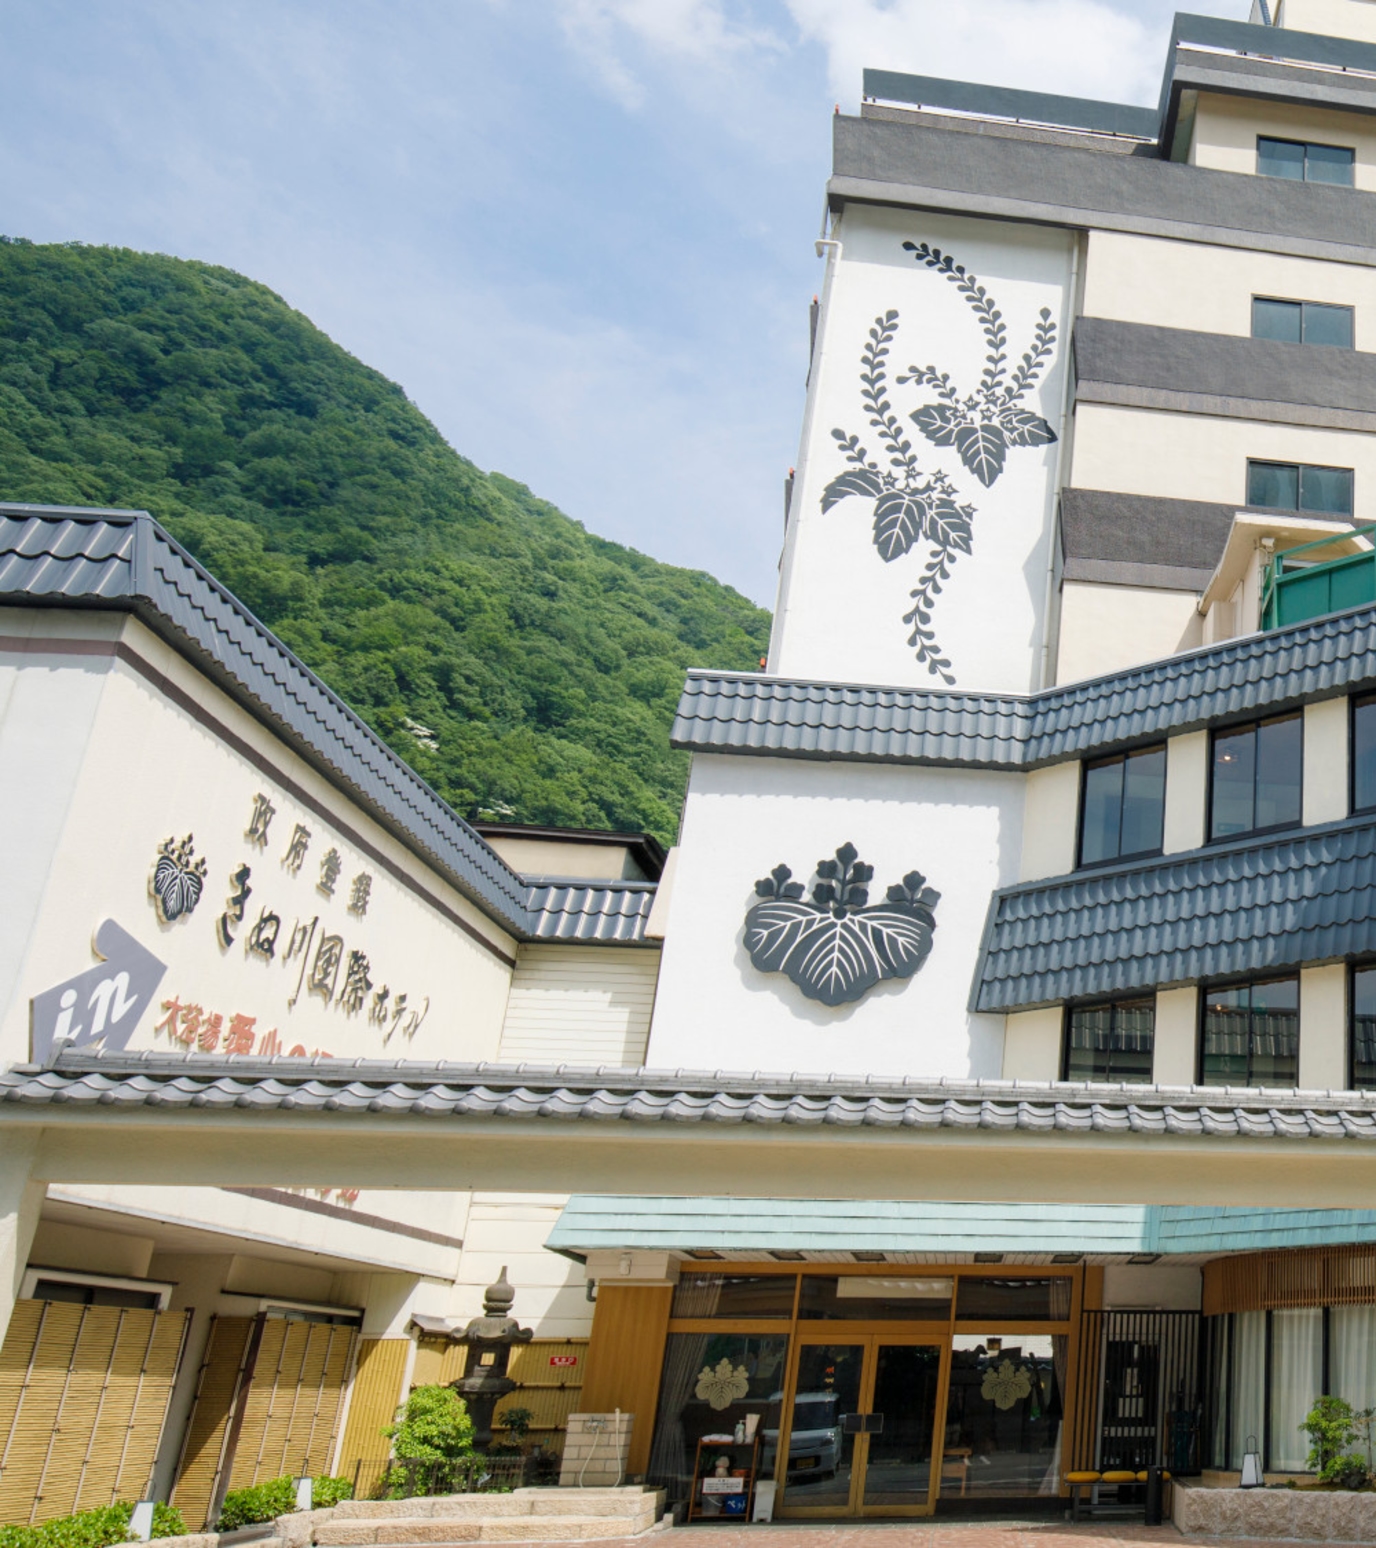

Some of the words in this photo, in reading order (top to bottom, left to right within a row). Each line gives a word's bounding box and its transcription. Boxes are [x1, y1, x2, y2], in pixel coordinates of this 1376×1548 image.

[53, 971, 138, 1040] in
[217, 862, 430, 1042] きぬ川国際ホテル
